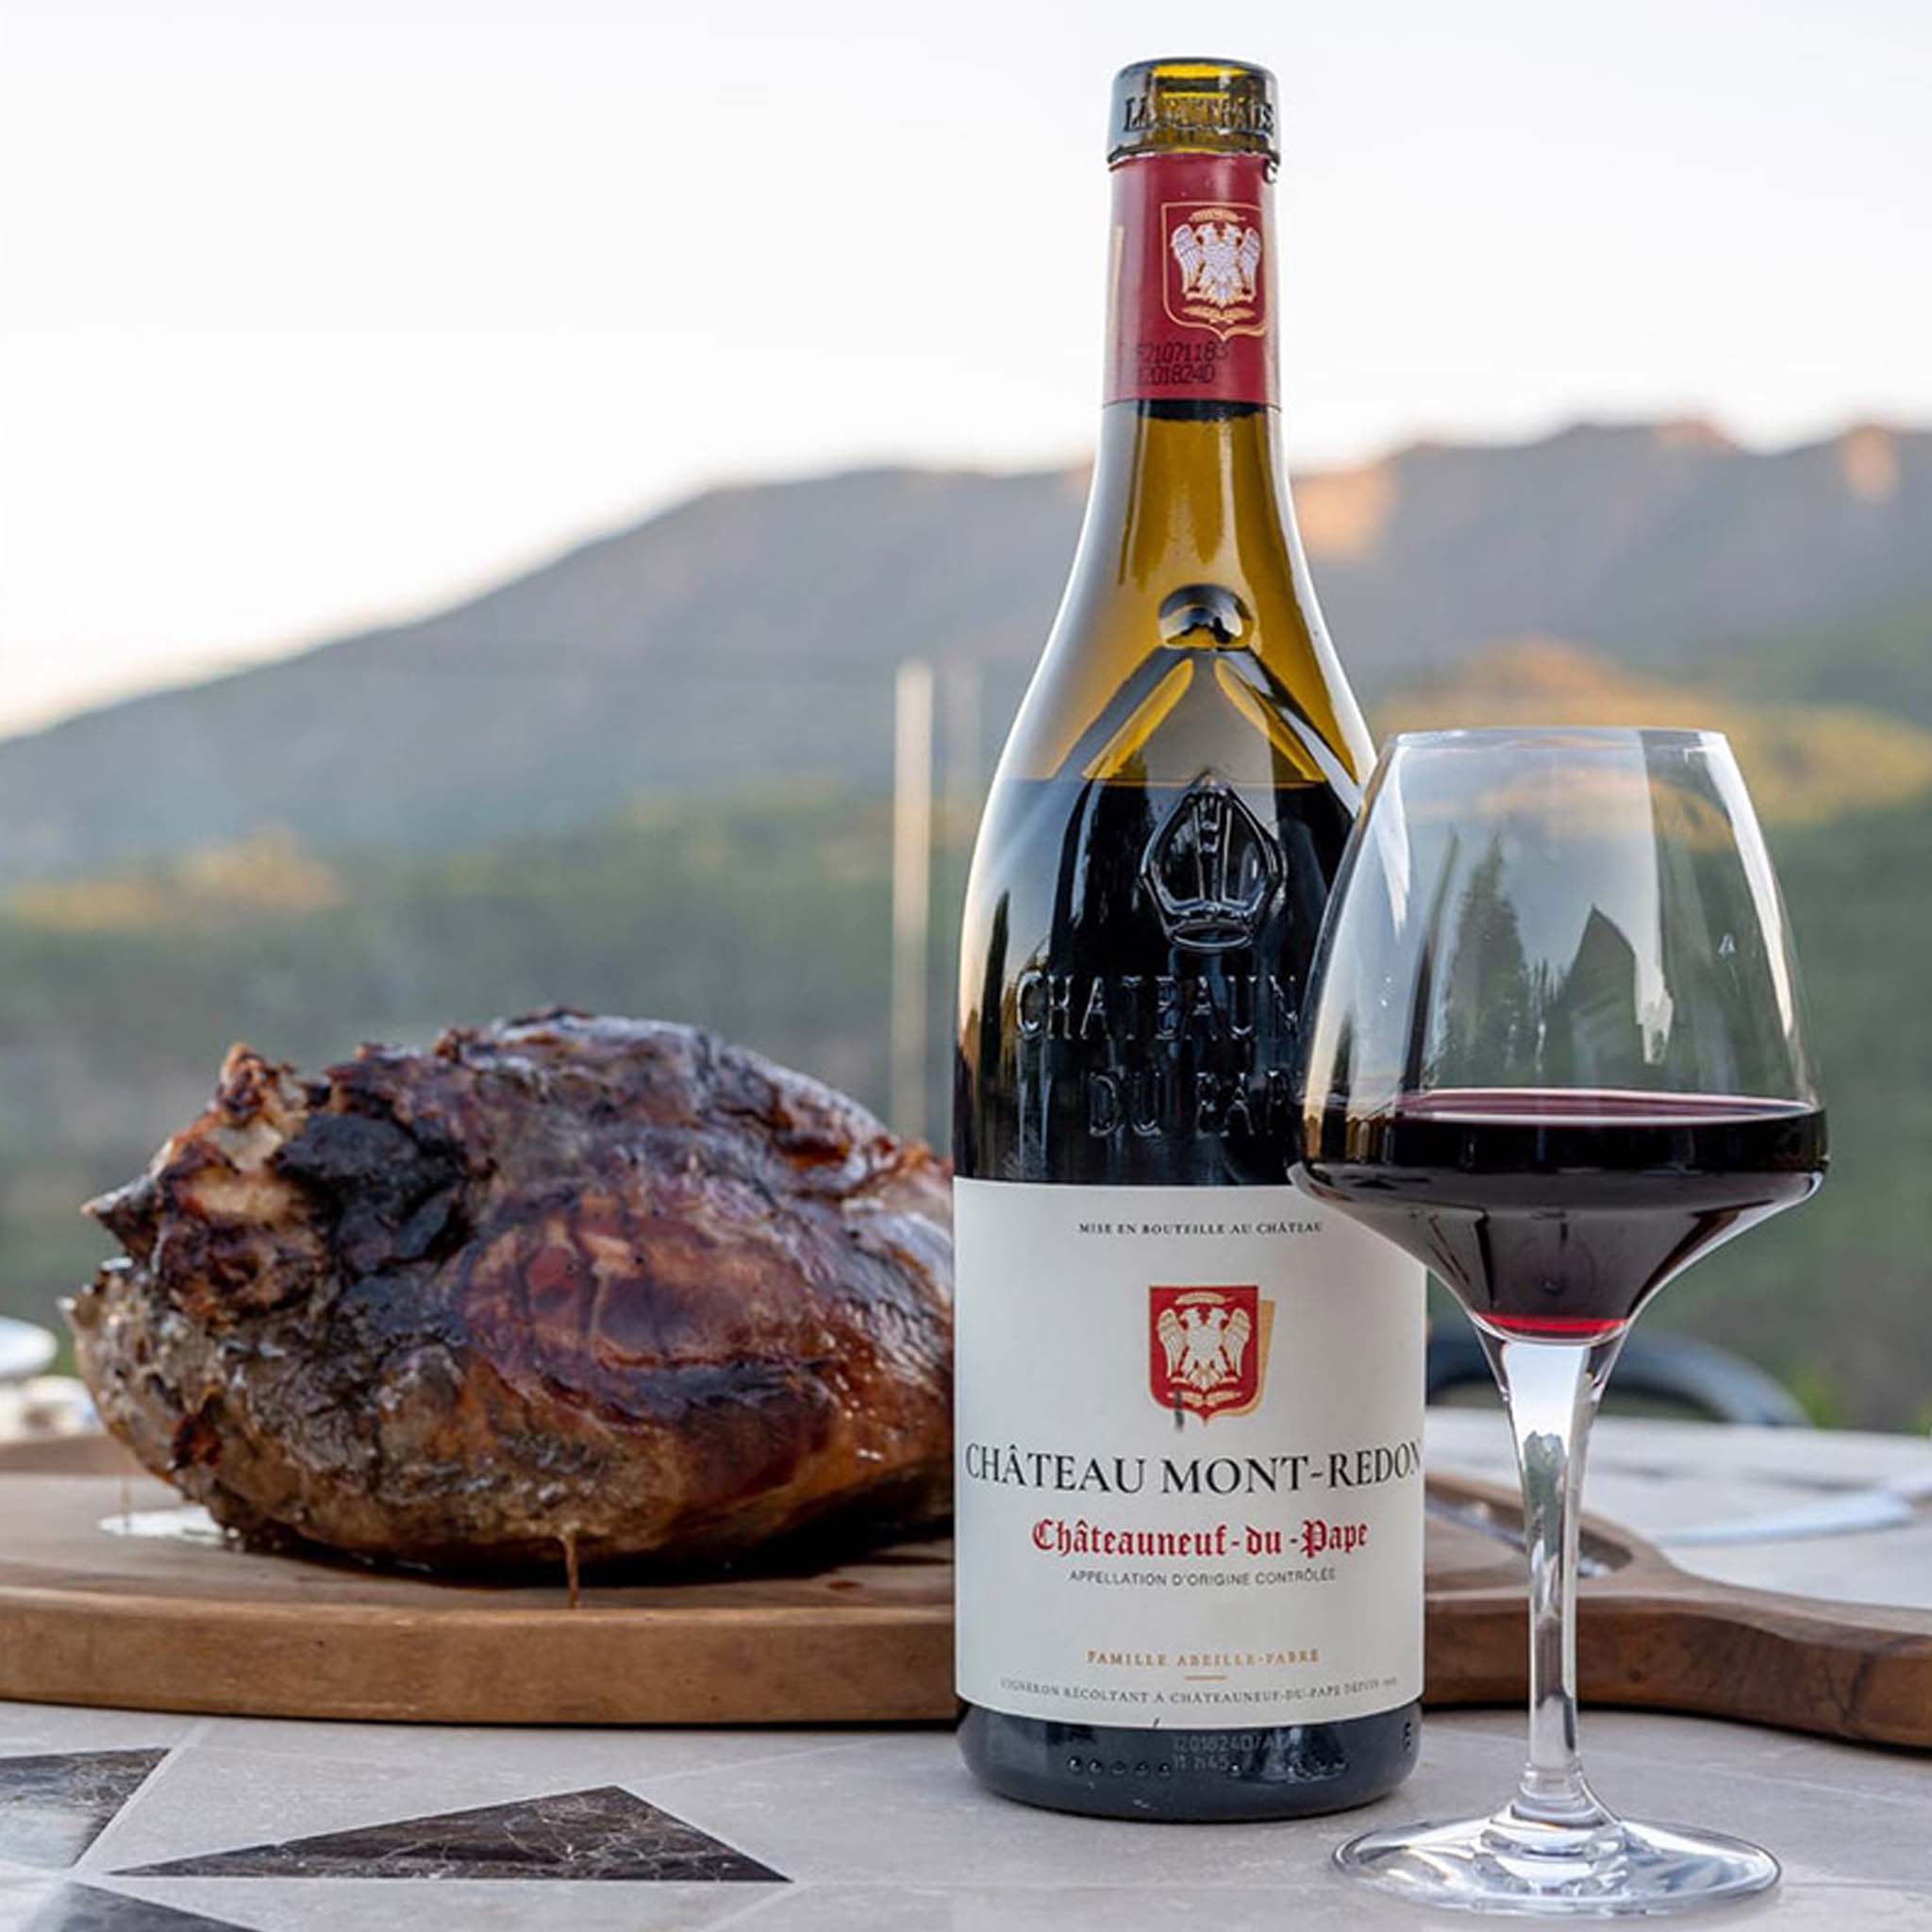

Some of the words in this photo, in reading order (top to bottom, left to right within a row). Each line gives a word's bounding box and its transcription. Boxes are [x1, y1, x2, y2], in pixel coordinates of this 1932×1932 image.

[1078, 1223, 1112, 1235] MISE
[1117, 1224, 1136, 1235] EN
[1142, 1224, 1224, 1235] BOUTEILLE
[1229, 1224, 1251, 1235] AU
[965, 1441, 1145, 1494] CHÂTEAU
[1160, 1439, 1422, 1494] MONT-REDON
[1069, 1570, 1167, 1586] APPELLATION
[1088, 1651, 1167, 1667] FAMILLE
